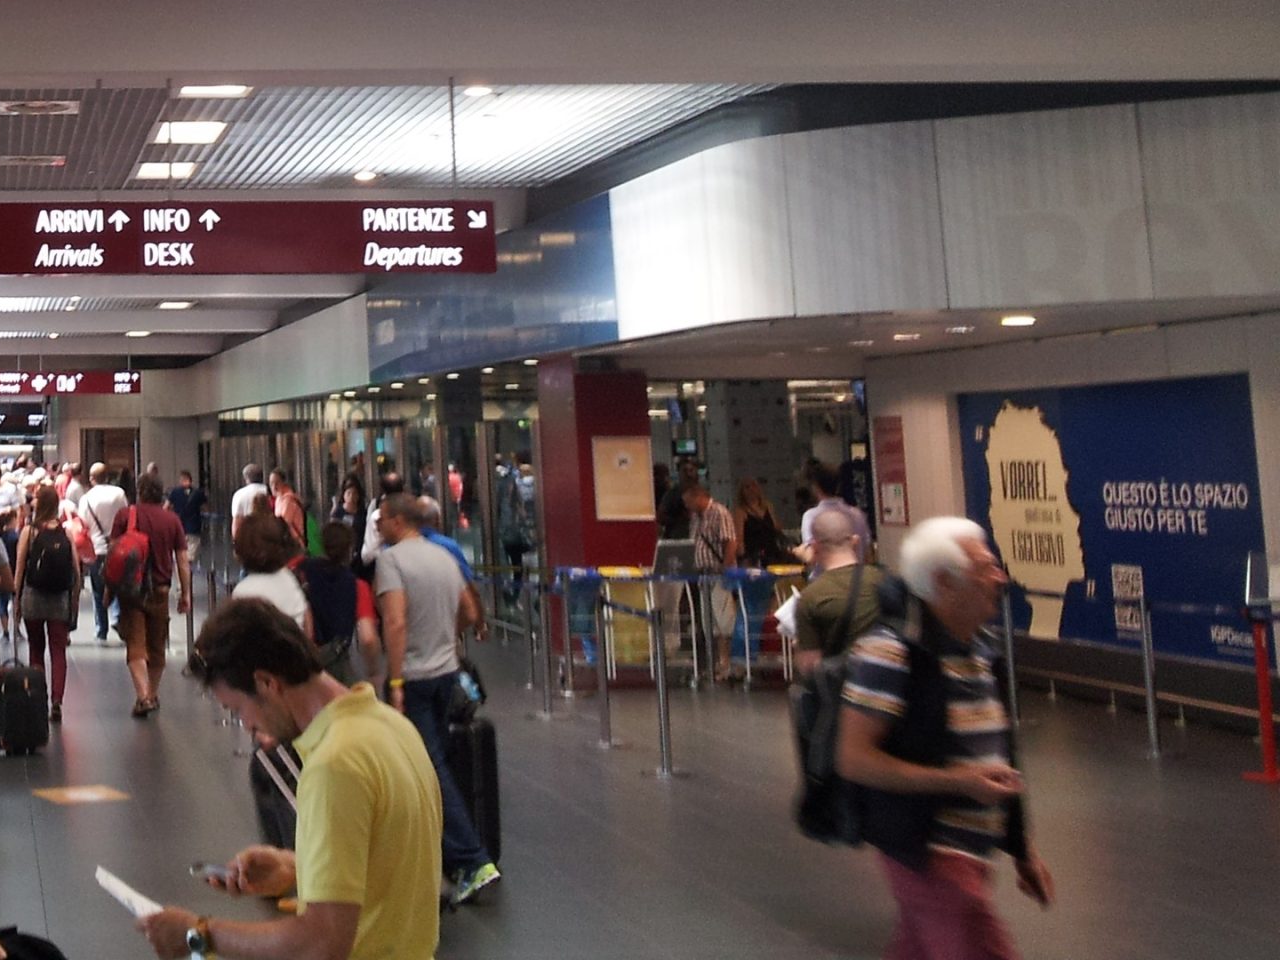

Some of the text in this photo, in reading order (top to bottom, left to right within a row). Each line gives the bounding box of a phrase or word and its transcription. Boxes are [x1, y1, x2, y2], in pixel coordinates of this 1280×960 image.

[35, 209, 104, 233] ARRIVI
[143, 208, 190, 232] INFO
[363, 207, 455, 232] PARTENZE
[34, 243, 104, 267] Arrivals
[143, 242, 194, 266] DESK
[363, 241, 463, 271] Departures
[1103, 476, 1249, 509] QUESTO È LO SPAZIO
[1104, 506, 1209, 535] GIUSTO PER TE
